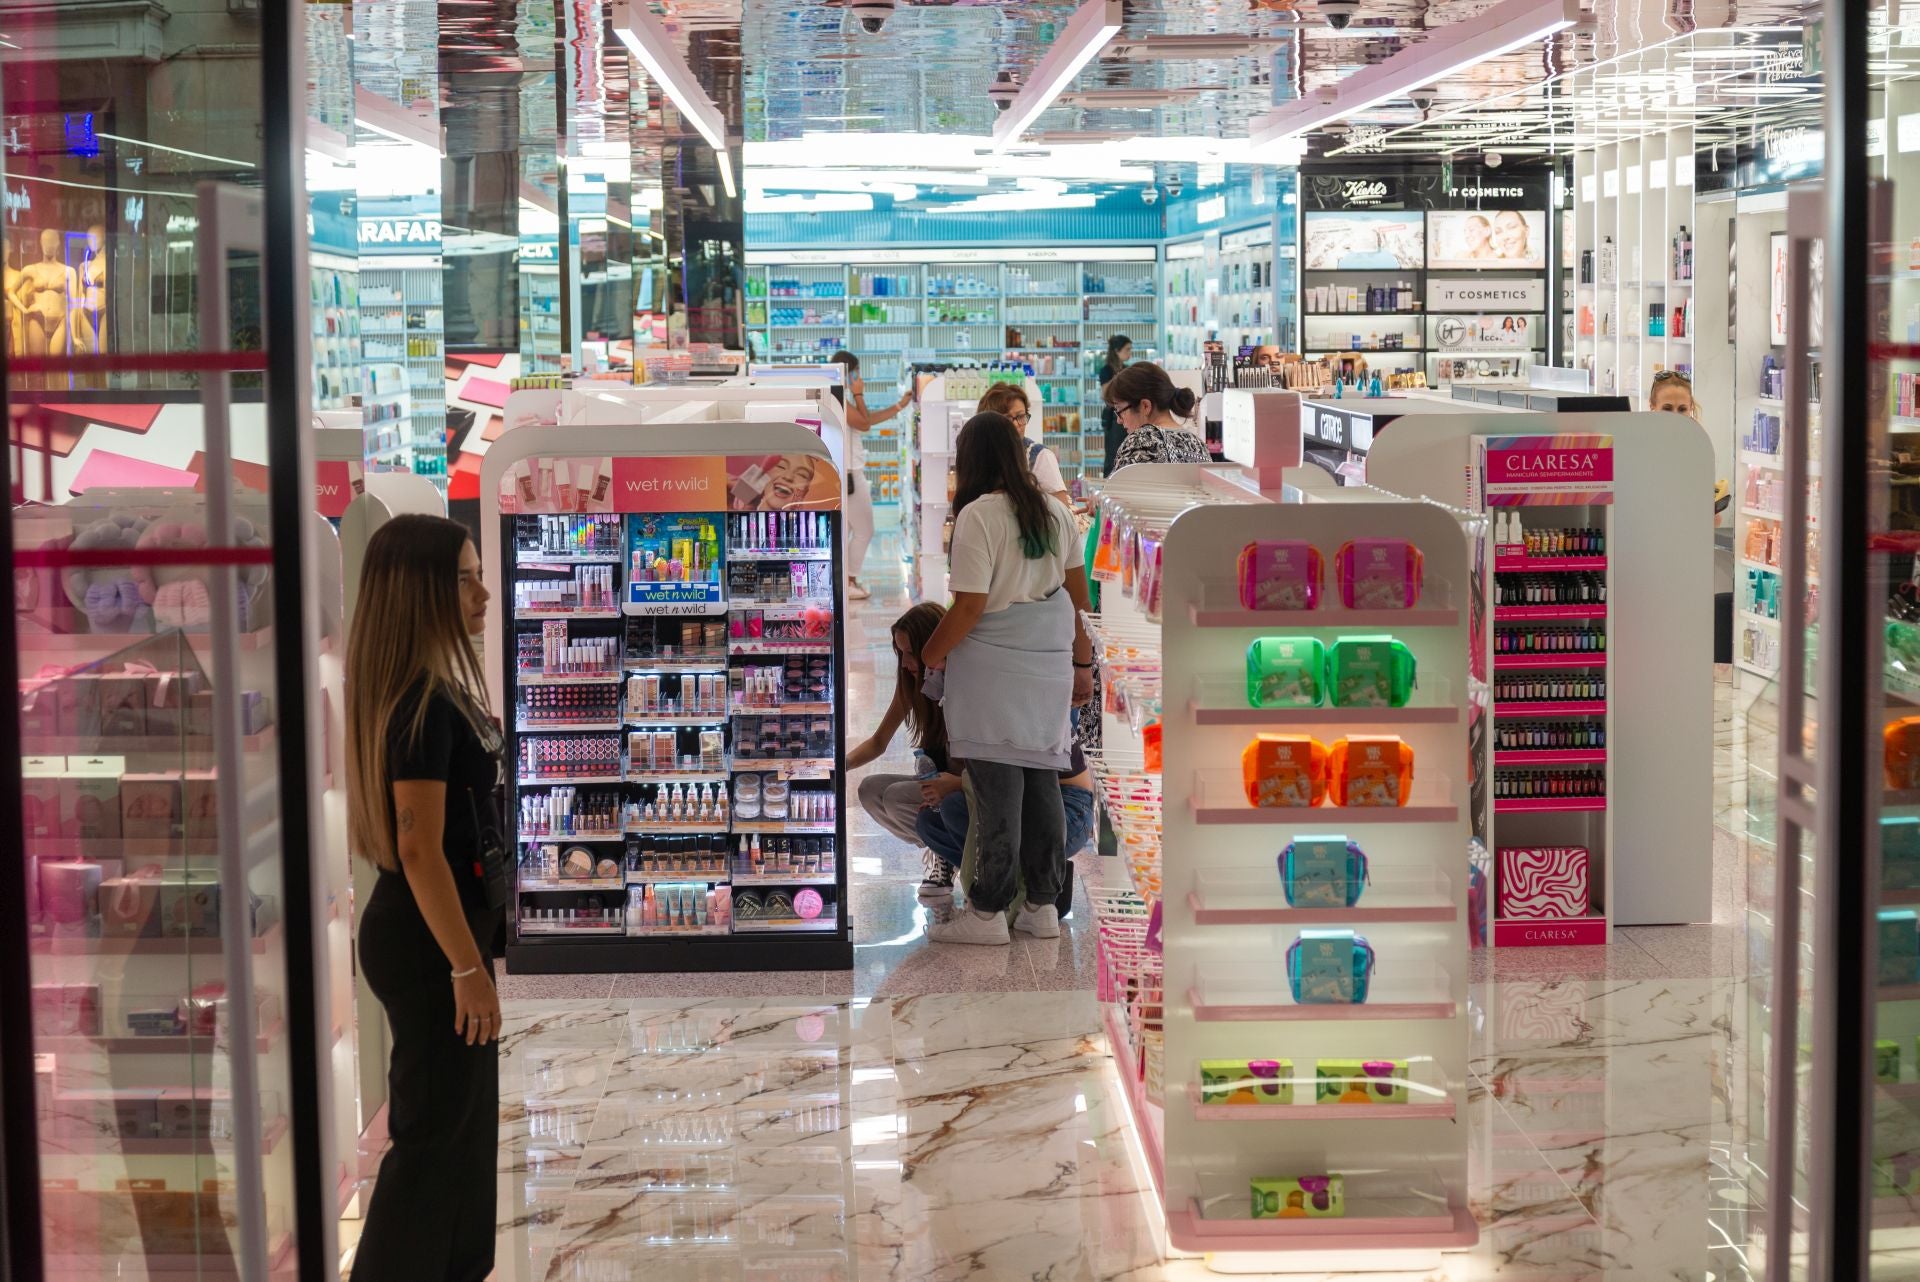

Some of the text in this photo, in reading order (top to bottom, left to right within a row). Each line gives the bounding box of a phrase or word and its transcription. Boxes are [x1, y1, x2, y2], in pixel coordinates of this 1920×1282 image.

[1342, 180, 1388, 197] Kiehl's
[1461, 187, 1524, 198] COSMETICS
[1459, 290, 1527, 300] COSMETICS
[1540, 470, 1594, 478] SEMIPERMANENTE
[625, 476, 709, 492] wet n wild
[645, 588, 706, 601] wet n wild
[644, 603, 706, 615] wet n wild
[1524, 929, 1576, 941] CLARESA
